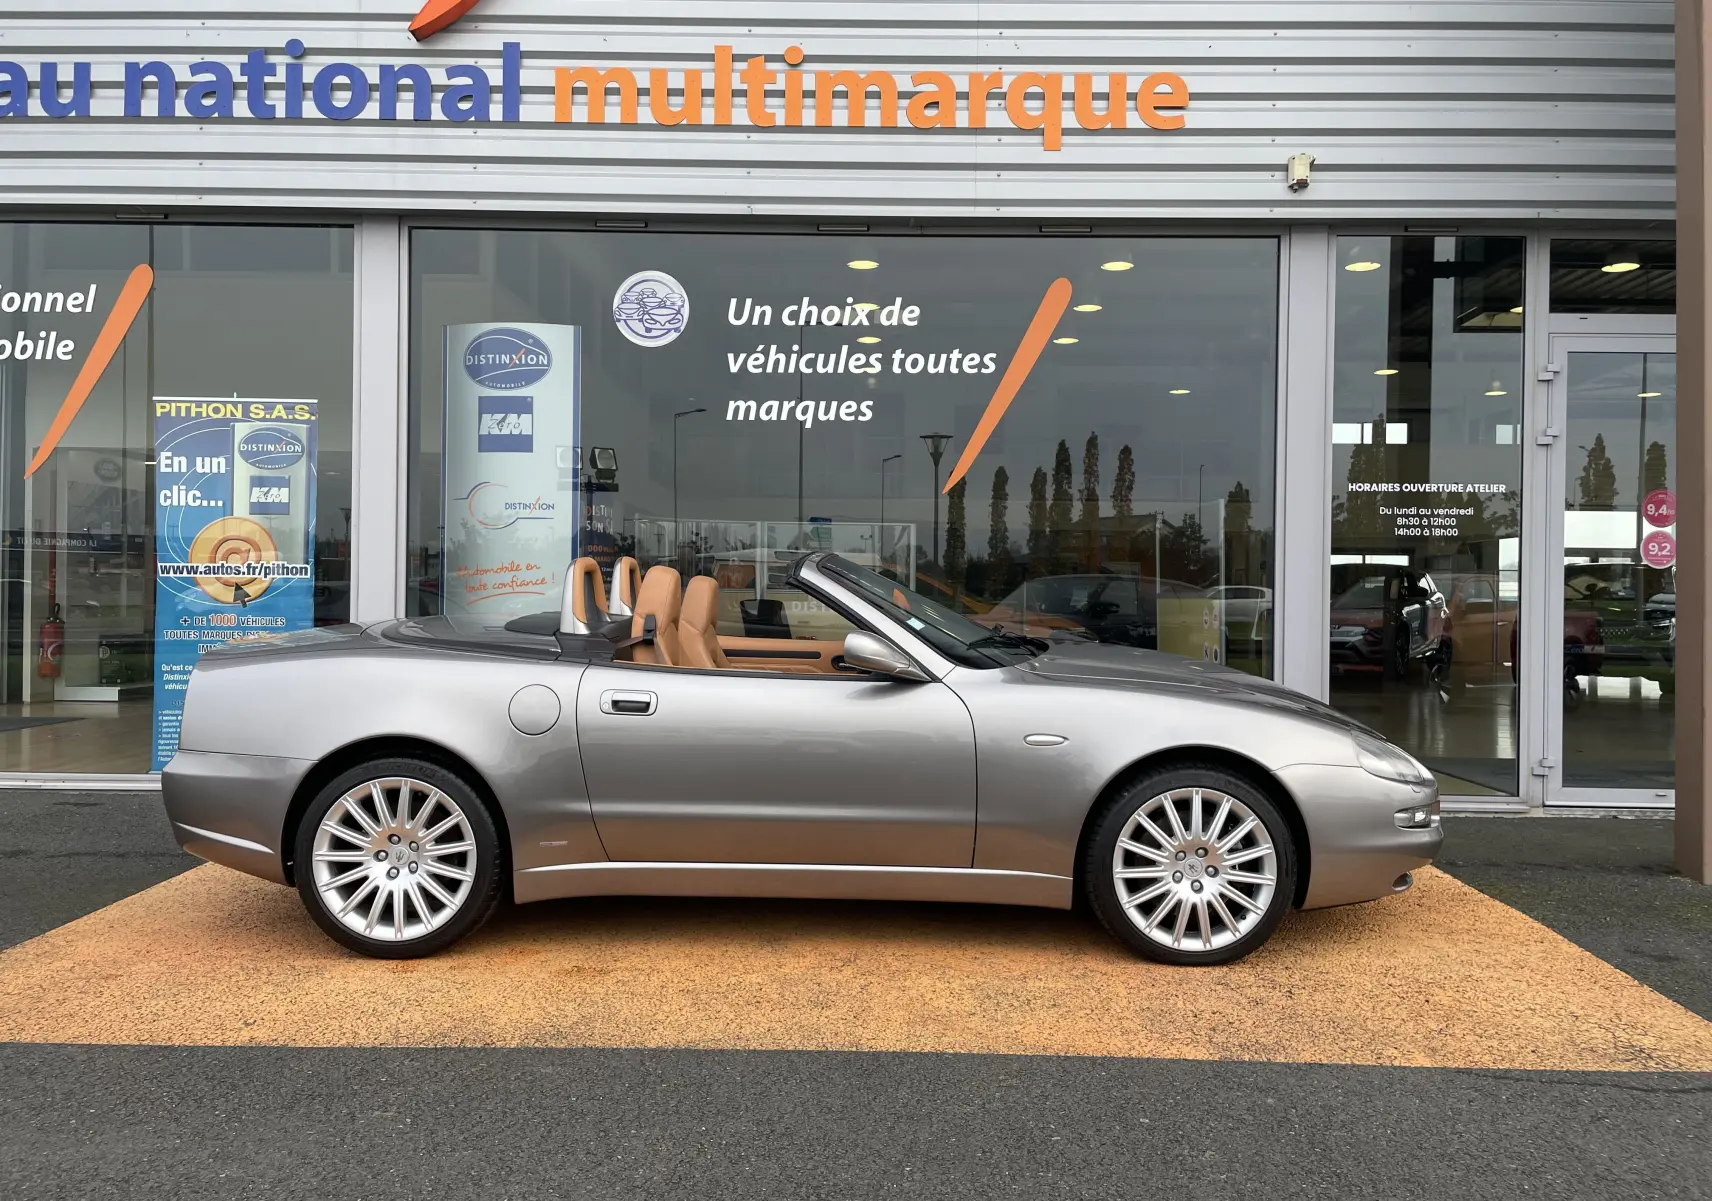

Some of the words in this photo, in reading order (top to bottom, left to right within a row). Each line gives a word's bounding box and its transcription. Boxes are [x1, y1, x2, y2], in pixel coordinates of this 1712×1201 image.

[123, 38, 521, 121] national
[554, 45, 1189, 151] multimarque
[0, 284, 97, 313] onnel
[727, 298, 772, 326] Un
[781, 297, 871, 326] choix
[880, 297, 921, 326] de
[727, 344, 883, 374] véhicules
[892, 349, 997, 374] toutes
[155, 402, 243, 418] PITHON
[249, 404, 316, 420] S.A.S.
[726, 399, 874, 428] marques
[159, 451, 187, 473] En
[195, 456, 226, 473] un
[159, 485, 223, 506] clic...
[1348, 483, 1400, 492] HORAIRES
[1402, 483, 1464, 493] OUVERTURE
[1465, 484, 1506, 493] ATELIER
[1380, 507, 1391, 515] Du
[1394, 507, 1417, 515] lundi
[1433, 507, 1474, 515] vendredi
[1397, 517, 1420, 526] 8h30
[1421, 517, 1428, 526] à
[1430, 518, 1456, 526] 12h00
[1394, 528, 1421, 536] 14h00
[1423, 528, 1429, 536] à
[1431, 528, 1458, 537] 18h00
[159, 562, 309, 579] www.autos.fr/pithon
[492, 575, 547, 591] confiance
[194, 616, 206, 626] DE
[209, 614, 237, 626] 1000
[240, 614, 285, 626] VÉHICULES
[164, 630, 199, 639] TOUTES
[202, 630, 242, 640] MARQUES
